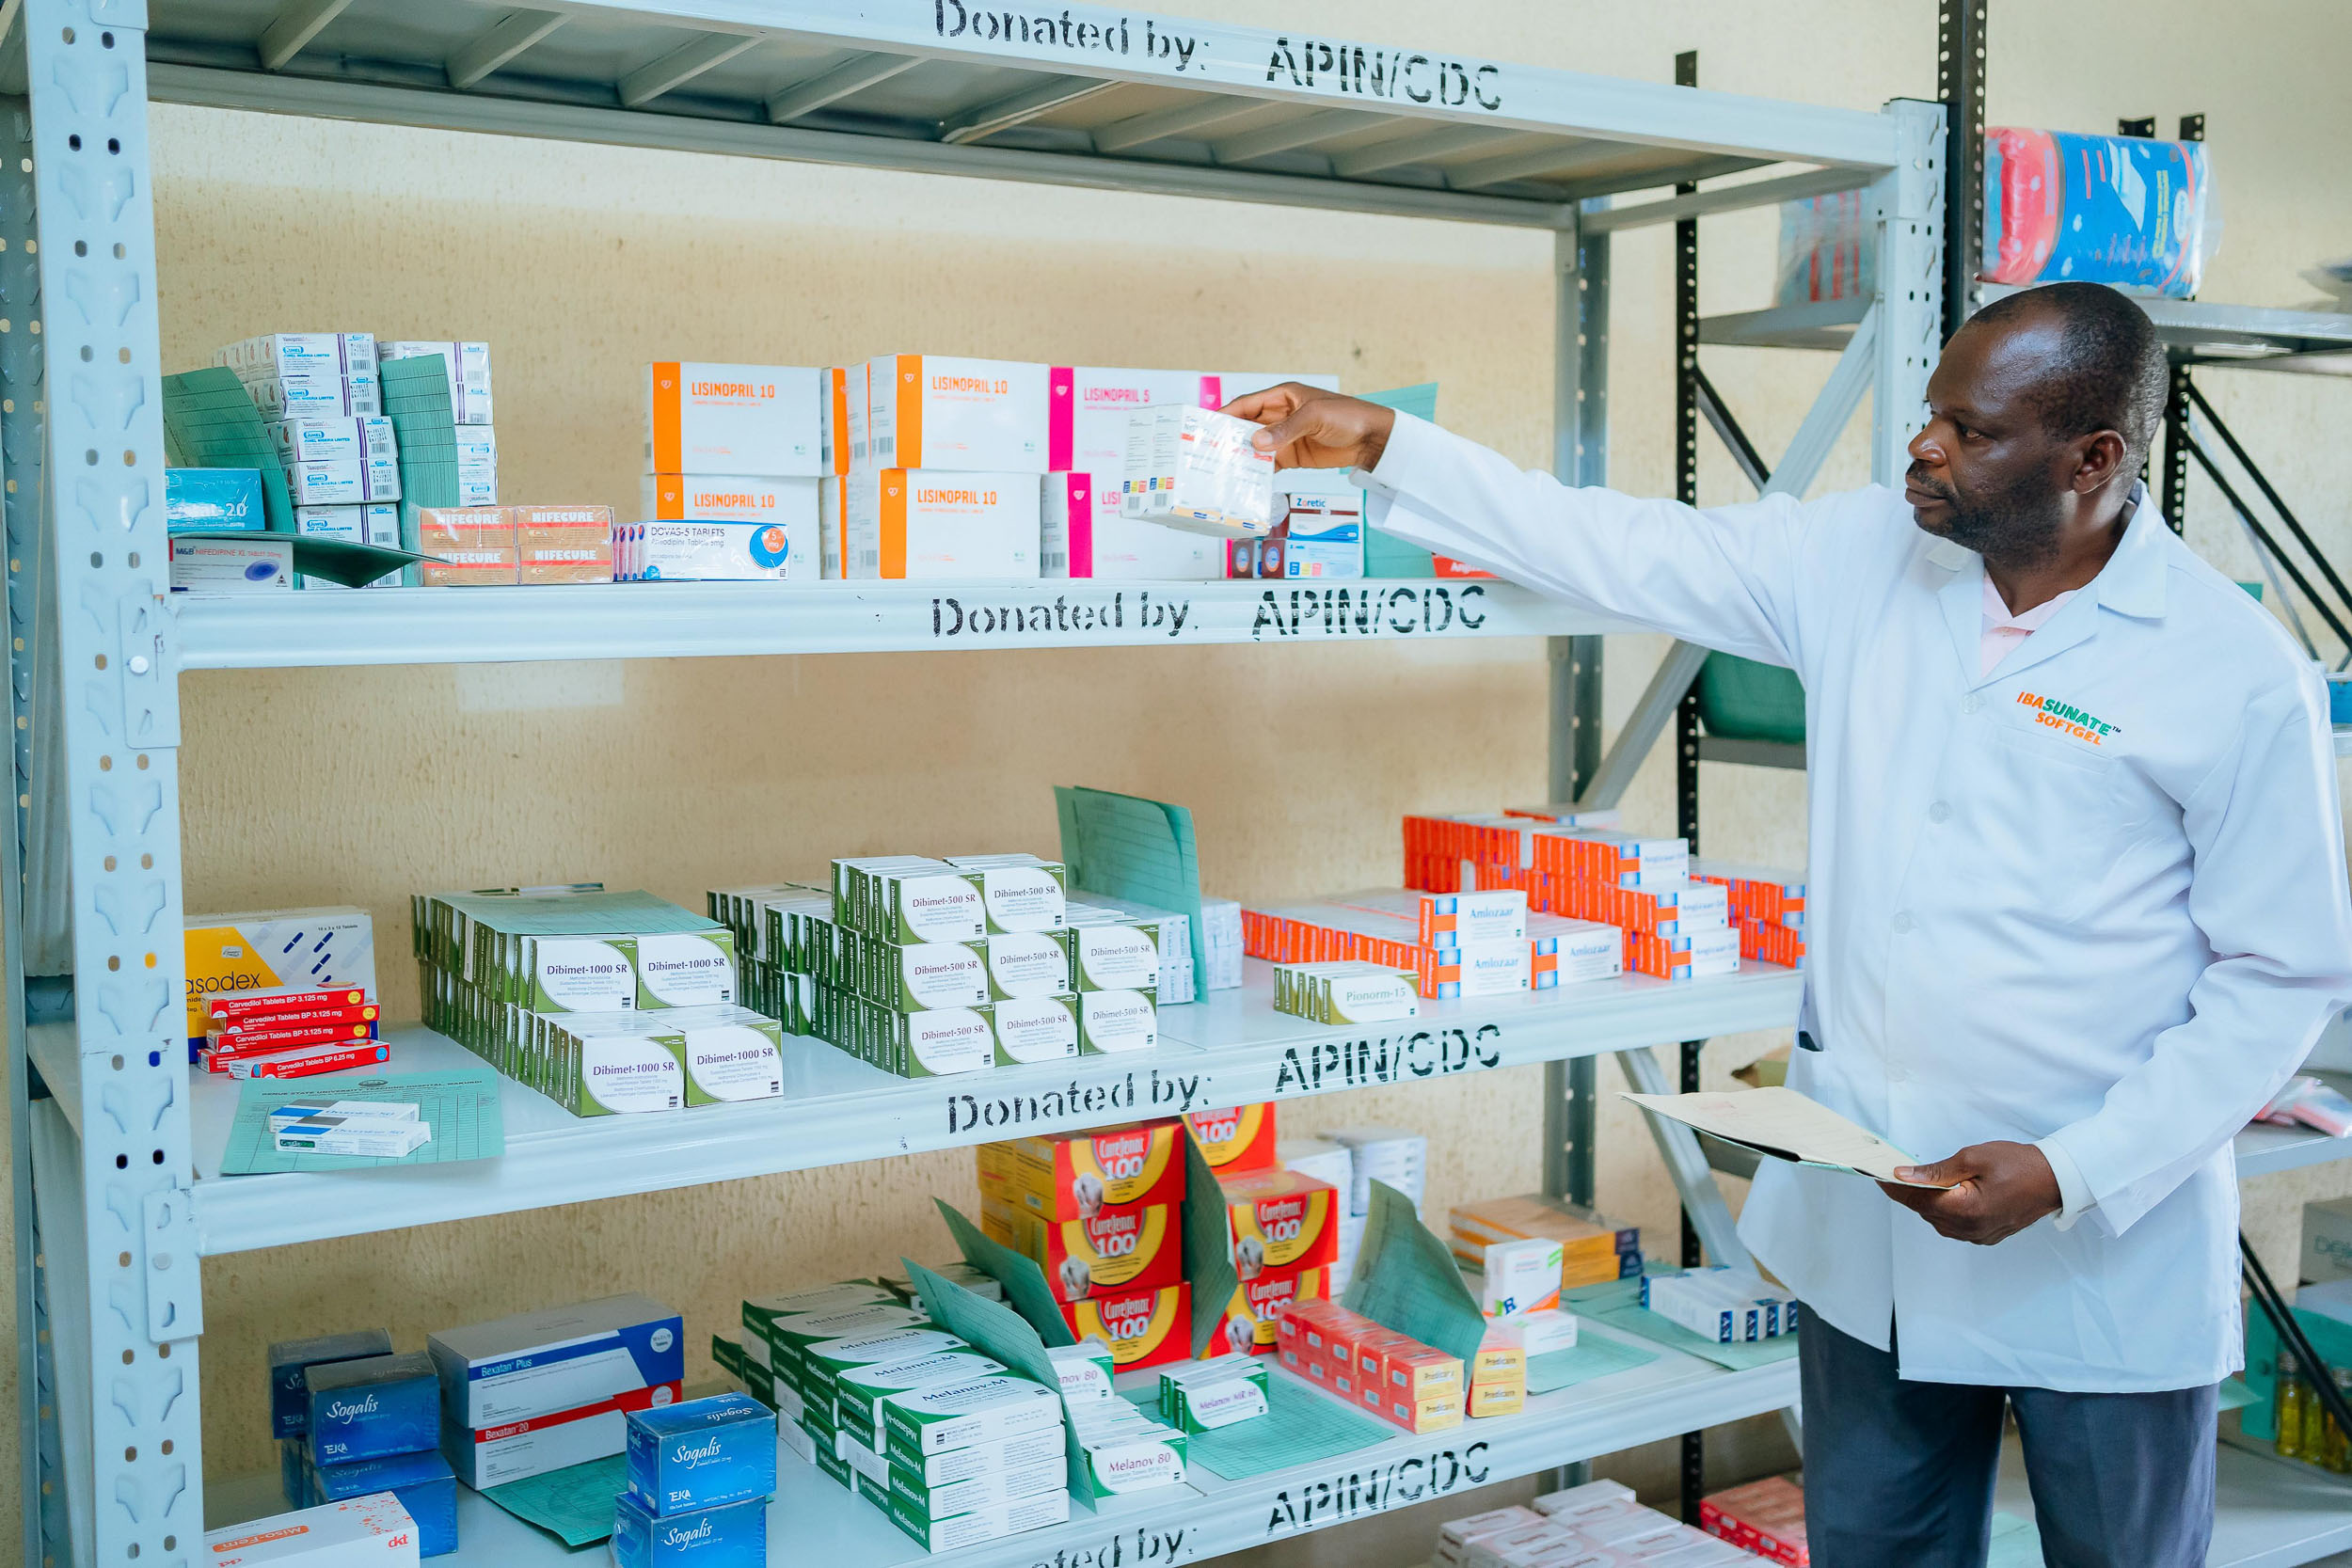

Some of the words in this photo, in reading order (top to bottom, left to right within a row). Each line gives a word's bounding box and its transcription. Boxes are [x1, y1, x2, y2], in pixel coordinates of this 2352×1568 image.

[934, 0, 1131, 55] Donated
[1266, 38, 1503, 111] APIN/CDC
[691, 382, 755, 398] LISINOPRIL
[760, 385, 775, 398] 10
[931, 375, 989, 394] LISINOPRIL
[994, 380, 1008, 395] 10
[1084, 387, 1140, 403] LISINOPRIL
[1144, 389, 1151, 402] 5
[694, 494, 756, 508] LISINOPRIL
[760, 495, 775, 508] 10
[917, 488, 978, 505] LISINOPRIL
[982, 490, 997, 505] 10
[532, 512, 594, 523] NIFECURE
[438, 552, 501, 563] NIFECURE
[534, 550, 596, 561] NIFECURE
[932, 593, 1123, 637] Donated
[1253, 586, 1486, 641] APIN/CDC
[2035, 712, 2101, 745] SOFTGEL
[913, 895, 963, 908] Dibimet-500
[994, 888, 1043, 899] Dibimet-500
[1469, 907, 1514, 919] Amlozaar
[1000, 952, 1048, 965] Dibimet-500
[1090, 946, 1141, 957] Dibimet-500
[548, 965, 612, 974] Dibimet-1000
[615, 964, 628, 973] SR
[648, 959, 710, 971] Dibimet-1000
[714, 958, 724, 967] SR
[914, 962, 965, 975] Dibimet-500
[1474, 957, 1518, 969] Amlozaar
[185, 971, 262, 994] asodex
[229, 999, 262, 1009] Carvedilol
[298, 994, 316, 1003] 3.125
[1346, 988, 1406, 1002] Pionorm-15
[243, 1015, 276, 1024] Carvedilol
[1007, 1016, 1056, 1030] Dibimet-500
[1057, 1014, 1068, 1023] SR
[1092, 1008, 1140, 1021] Dibimet-500
[1142, 1006, 1149, 1015] SR
[235, 1034, 268, 1043] Carvedilol
[269, 1031, 292, 1039] Tablets
[922, 1026, 972, 1040] Dibimet-500
[974, 1024, 984, 1033] SR
[277, 1061, 305, 1071] Carvedilol
[306, 1057, 324, 1068] Tablets
[334, 1054, 344, 1063] 6.25
[697, 1050, 759, 1065] Dibimet-1000
[762, 1048, 773, 1057] SR
[594, 1063, 660, 1075] Dibimet-1000
[662, 1062, 675, 1070] SR
[948, 1072, 1133, 1133] Donated
[1152, 1069, 1211, 1112] by:
[1276, 1023, 1502, 1093] APIN/CDC
[1199, 1121, 1236, 1145] 100
[1104, 1156, 1144, 1181] 100
[1264, 1220, 1301, 1243] 100
[1096, 1234, 1136, 1259] 100
[1110, 1316, 1149, 1341] 100
[839, 1331, 920, 1350] Melanov-M
[481, 1363, 512, 1376] Bexatan
[516, 1359, 532, 1370] Plus
[874, 1354, 958, 1376] Melanov-M
[1084, 1370, 1098, 1380] 80
[922, 1378, 1009, 1402] Melanov-M
[326, 1394, 378, 1425] Sogalis
[485, 1427, 516, 1440] Bexatan
[519, 1423, 529, 1433] 20
[672, 1436, 721, 1469] Sogalis
[890, 1443, 921, 1474] Melanov-M
[1108, 1453, 1154, 1473] Melanov
[1157, 1452, 1171, 1465] 80
[893, 1477, 926, 1507] Melanov-M
[1137, 1528, 1197, 1564] by:
[1267, 1442, 1489, 1536] APIN/CDC
[895, 1508, 926, 1540] Melanov-M
[222, 1527, 302, 1548] Miso-Fem
[388, 1534, 408, 1549] dkt
[664, 1518, 712, 1551] Sogalis
